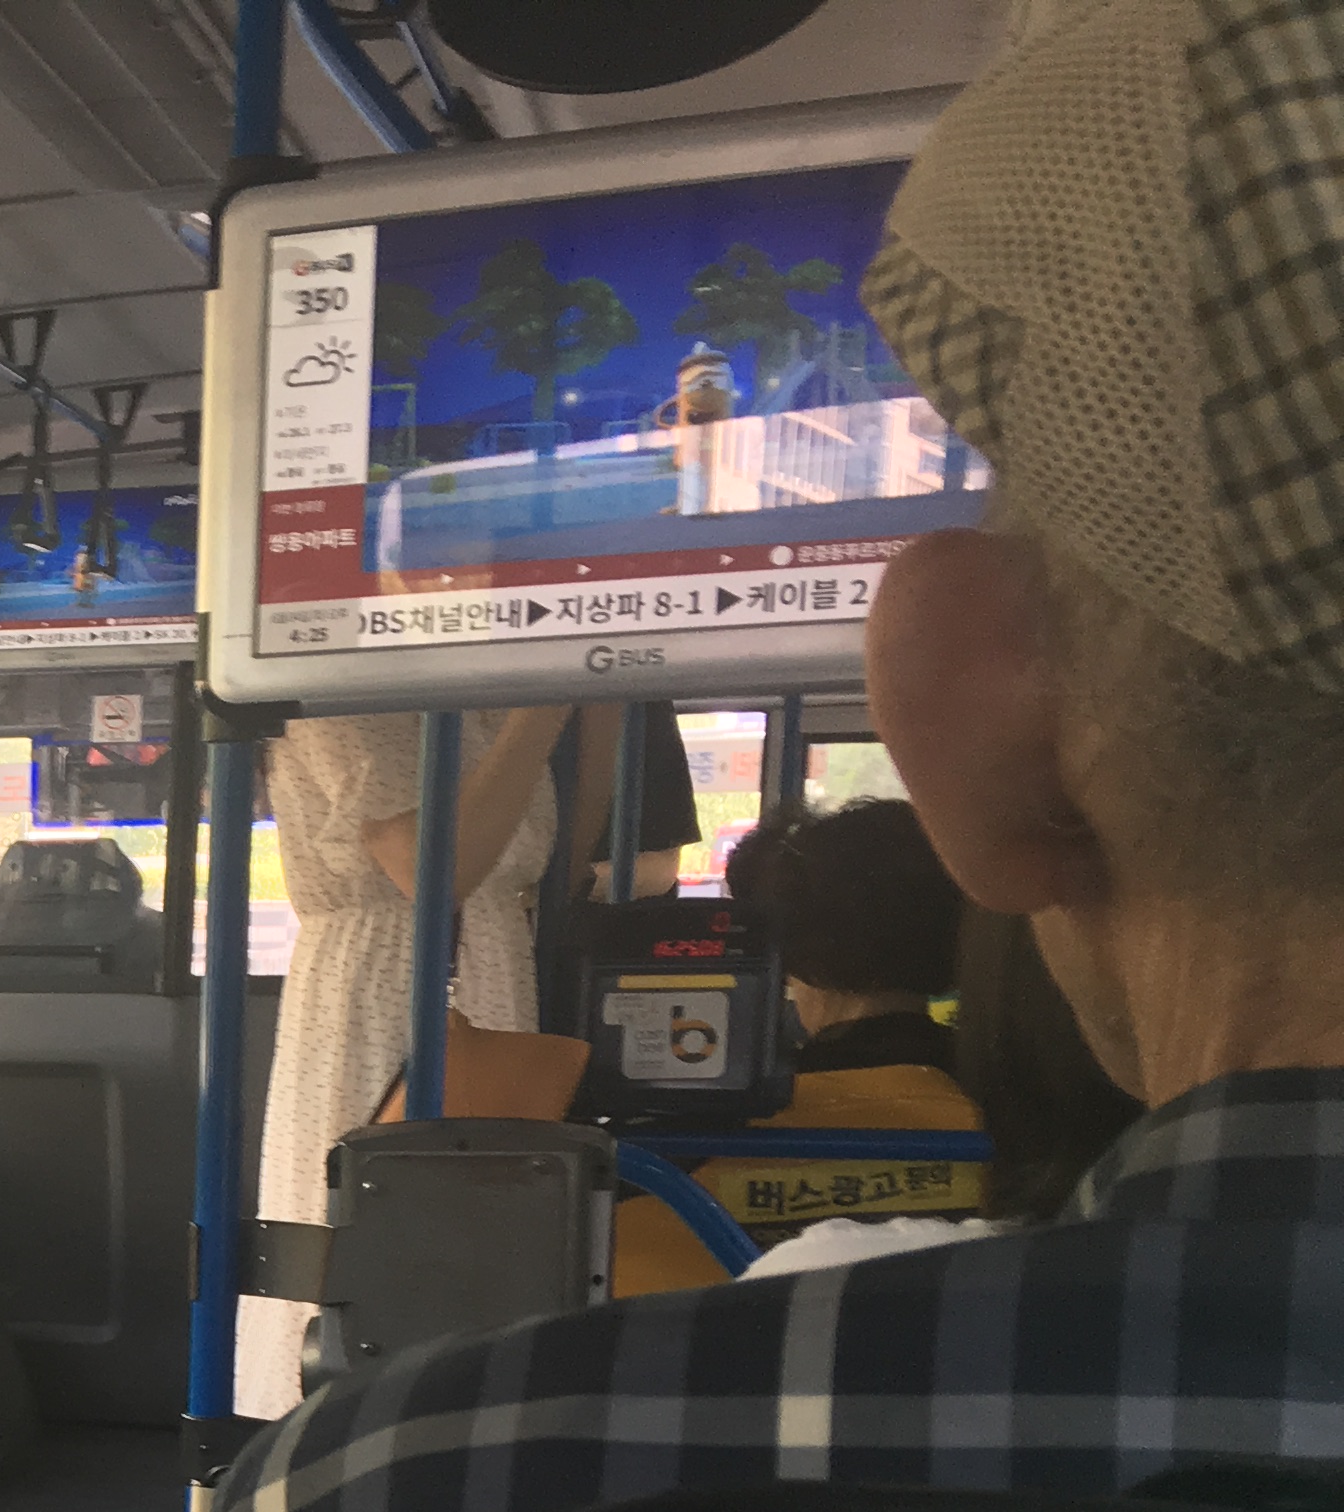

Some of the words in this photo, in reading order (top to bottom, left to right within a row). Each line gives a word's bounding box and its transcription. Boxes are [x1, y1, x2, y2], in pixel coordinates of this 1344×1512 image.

[296, 287, 349, 314] 350
[557, 590, 645, 625] 지상파
[653, 590, 703, 617] 8-1
[746, 578, 842, 613] 케이블
[746, 1171, 903, 1216] 버스광고
